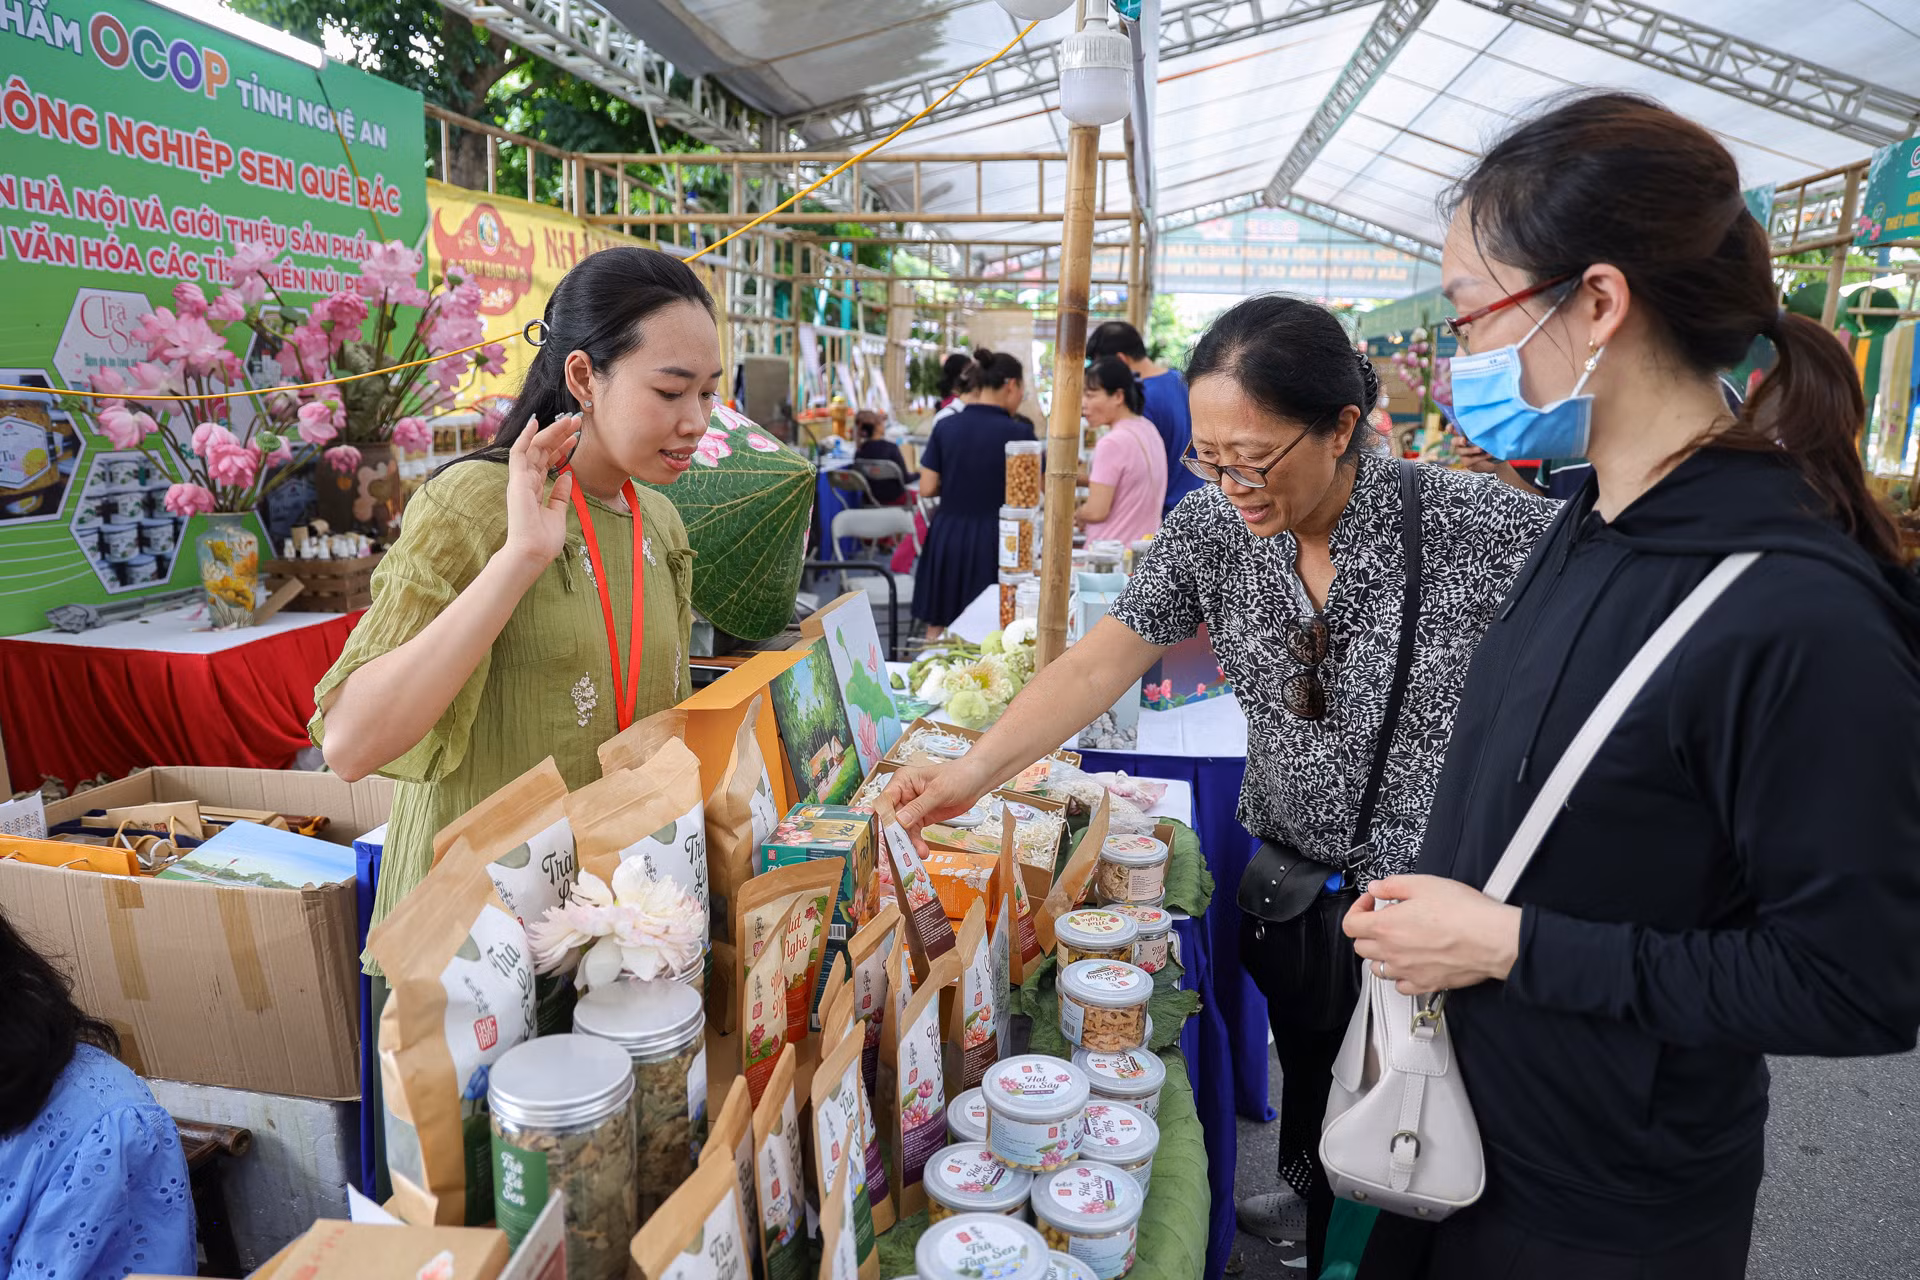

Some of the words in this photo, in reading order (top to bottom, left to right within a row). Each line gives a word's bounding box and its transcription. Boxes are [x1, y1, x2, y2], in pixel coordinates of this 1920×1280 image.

[89, 12, 229, 98] OCOP
[236, 73, 293, 121] TỈNH
[298, 108, 356, 144] NGHỆ
[359, 120, 387, 149] AN
[0, 76, 99, 147] ÔNG
[106, 115, 233, 182] NGHIỆP
[239, 148, 295, 193] SEN
[300, 166, 352, 204] QUÊ
[357, 174, 400, 215] BÁC
[9, 224, 76, 265] VĂN
[82, 236, 144, 273] HÓA
[148, 245, 199, 279] CÁC
[23, 177, 71, 215] HÀ
[75, 187, 128, 229] NỘI
[131, 196, 168, 231] VÀ
[172, 205, 221, 240] GIỚI
[290, 222, 328, 256] SẢN
